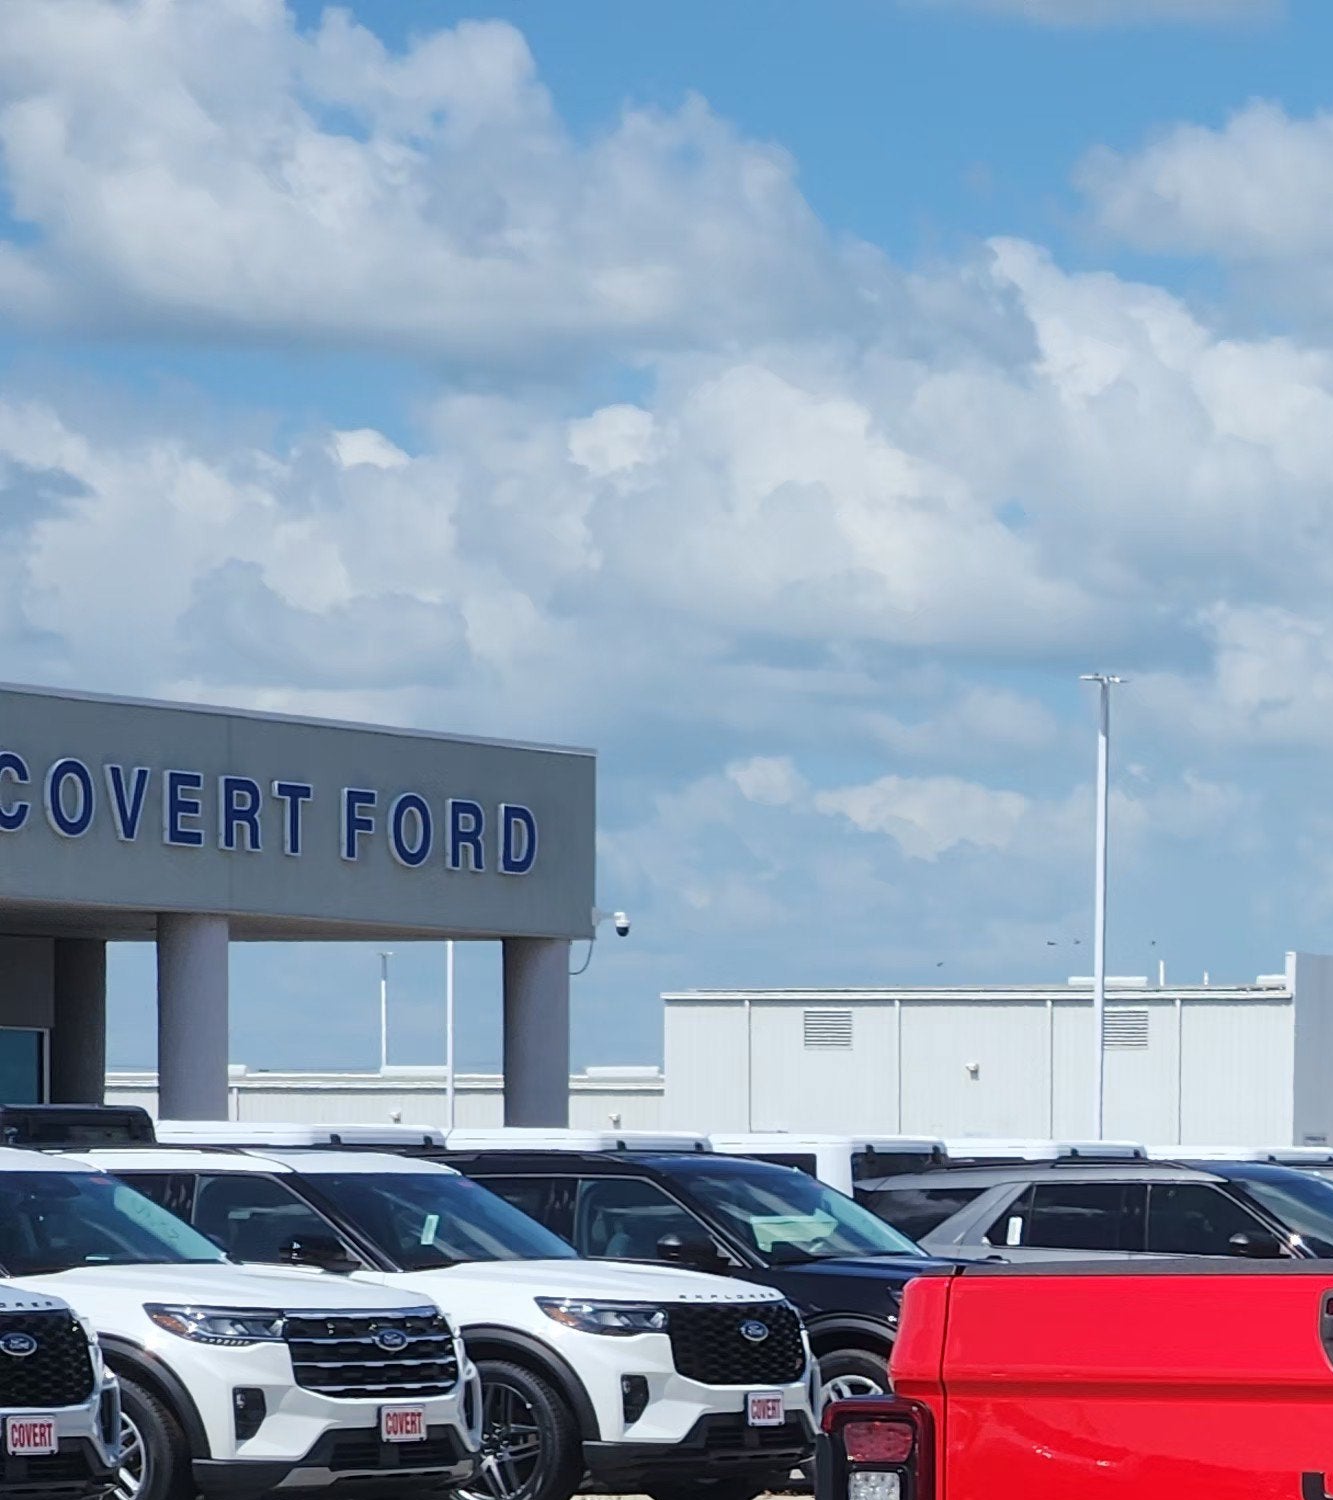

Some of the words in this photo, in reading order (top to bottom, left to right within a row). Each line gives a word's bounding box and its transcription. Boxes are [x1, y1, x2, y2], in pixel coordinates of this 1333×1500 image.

[0, 752, 312, 856] COVERT
[341, 788, 538, 875] FORD
[11, 1423, 53, 1447] COVERT
[385, 1412, 422, 1435] COVERT
